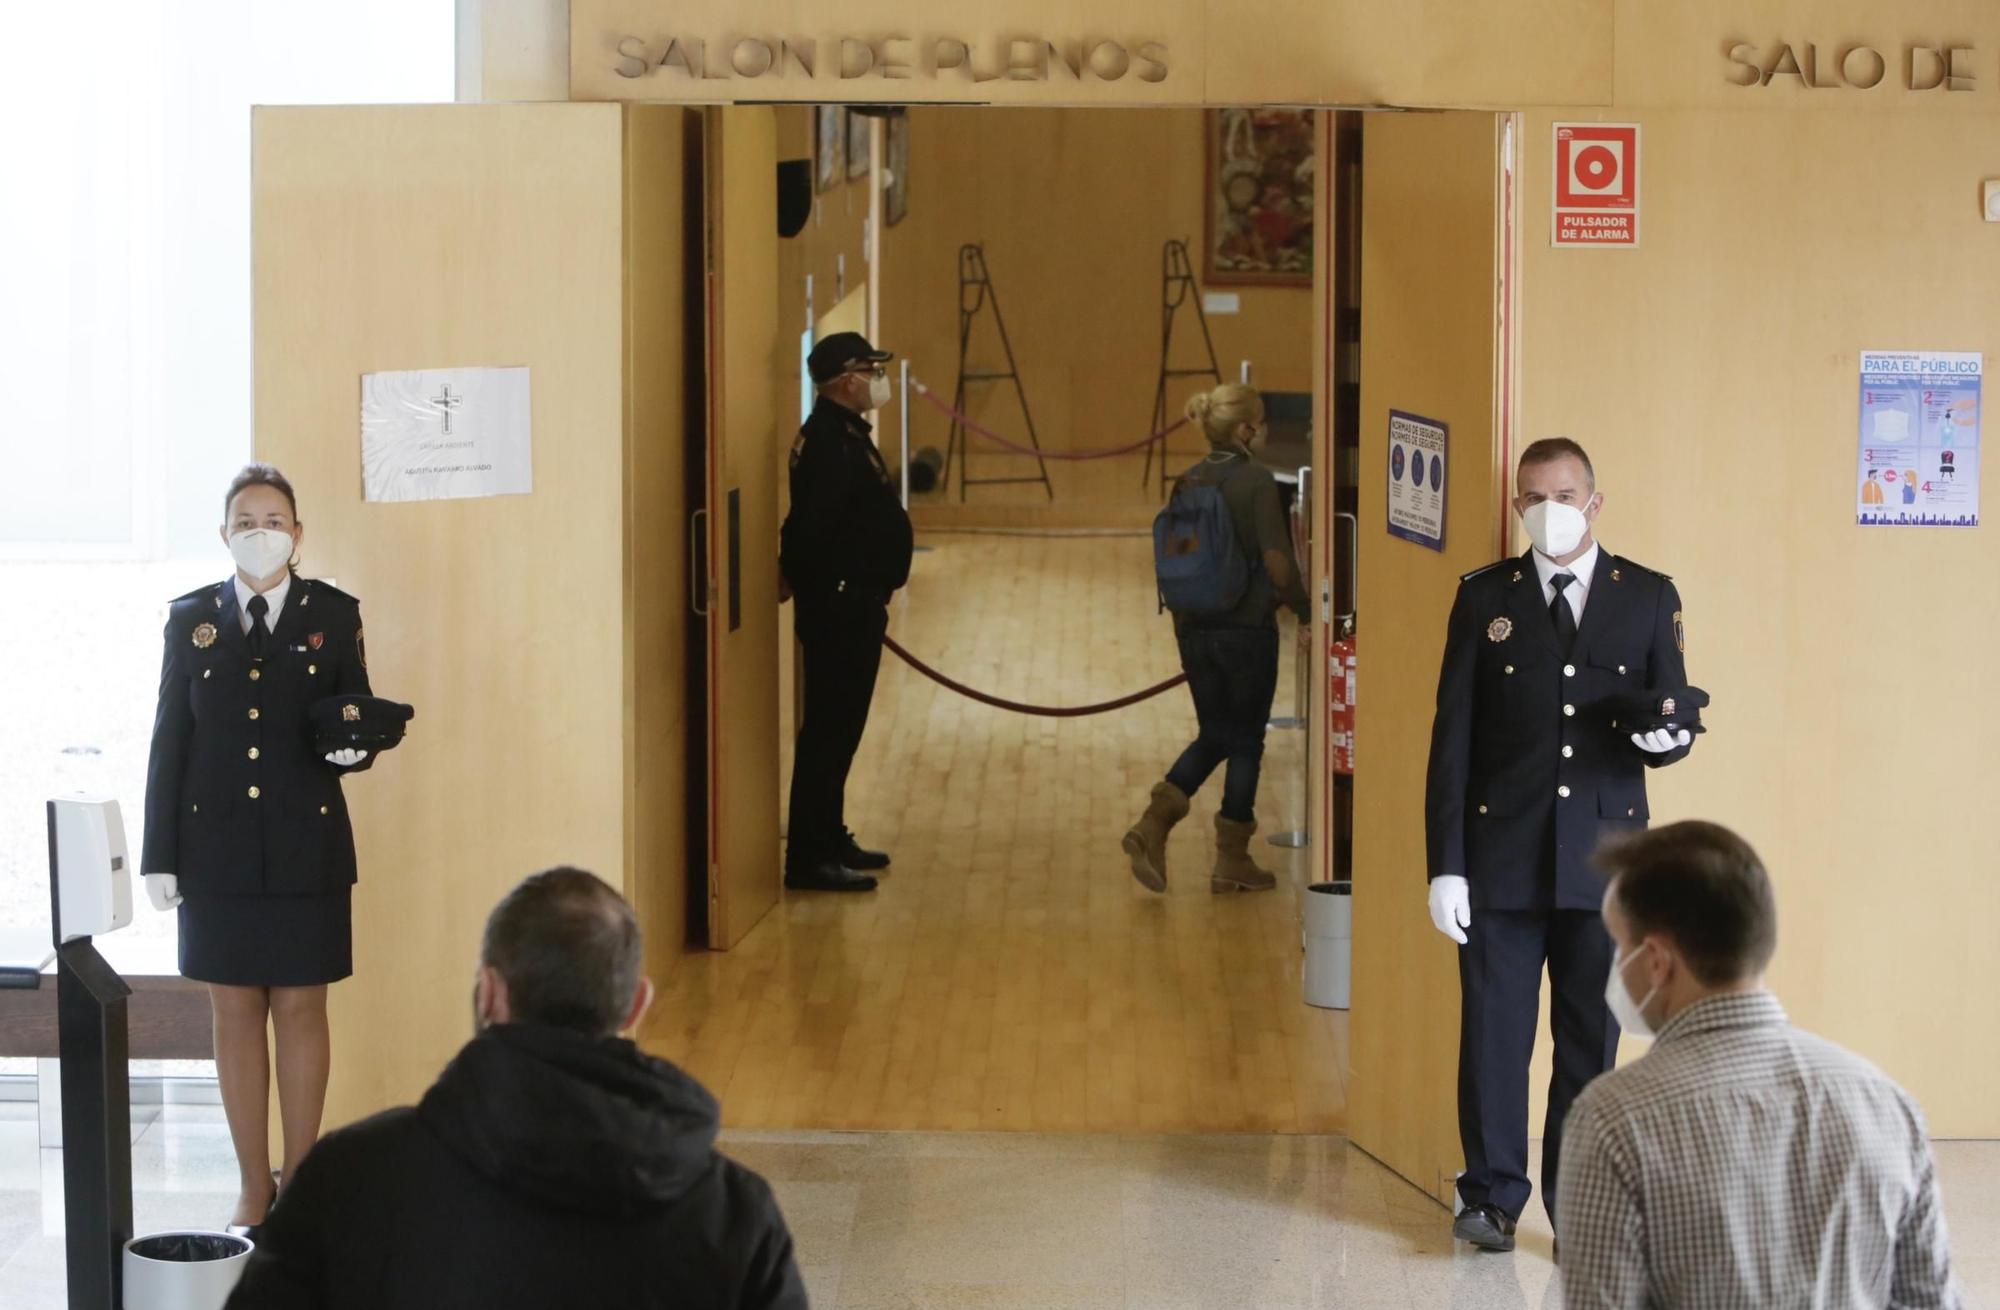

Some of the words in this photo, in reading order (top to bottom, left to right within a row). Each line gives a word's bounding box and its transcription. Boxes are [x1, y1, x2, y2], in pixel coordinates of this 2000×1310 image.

[614, 37, 815, 79] SALON
[839, 38, 911, 79] DE
[1906, 46, 1976, 92] DE
[1563, 216, 1628, 227] PULSADOR
[1561, 229, 1577, 239] DE
[1580, 229, 1630, 239] ALARMA
[1865, 360, 1899, 372] PARA
[1903, 360, 1918, 372] EL
[1921, 358, 1979, 373] PÚBLICO
[1865, 449, 1873, 461] 3
[1922, 481, 1932, 493] 4
